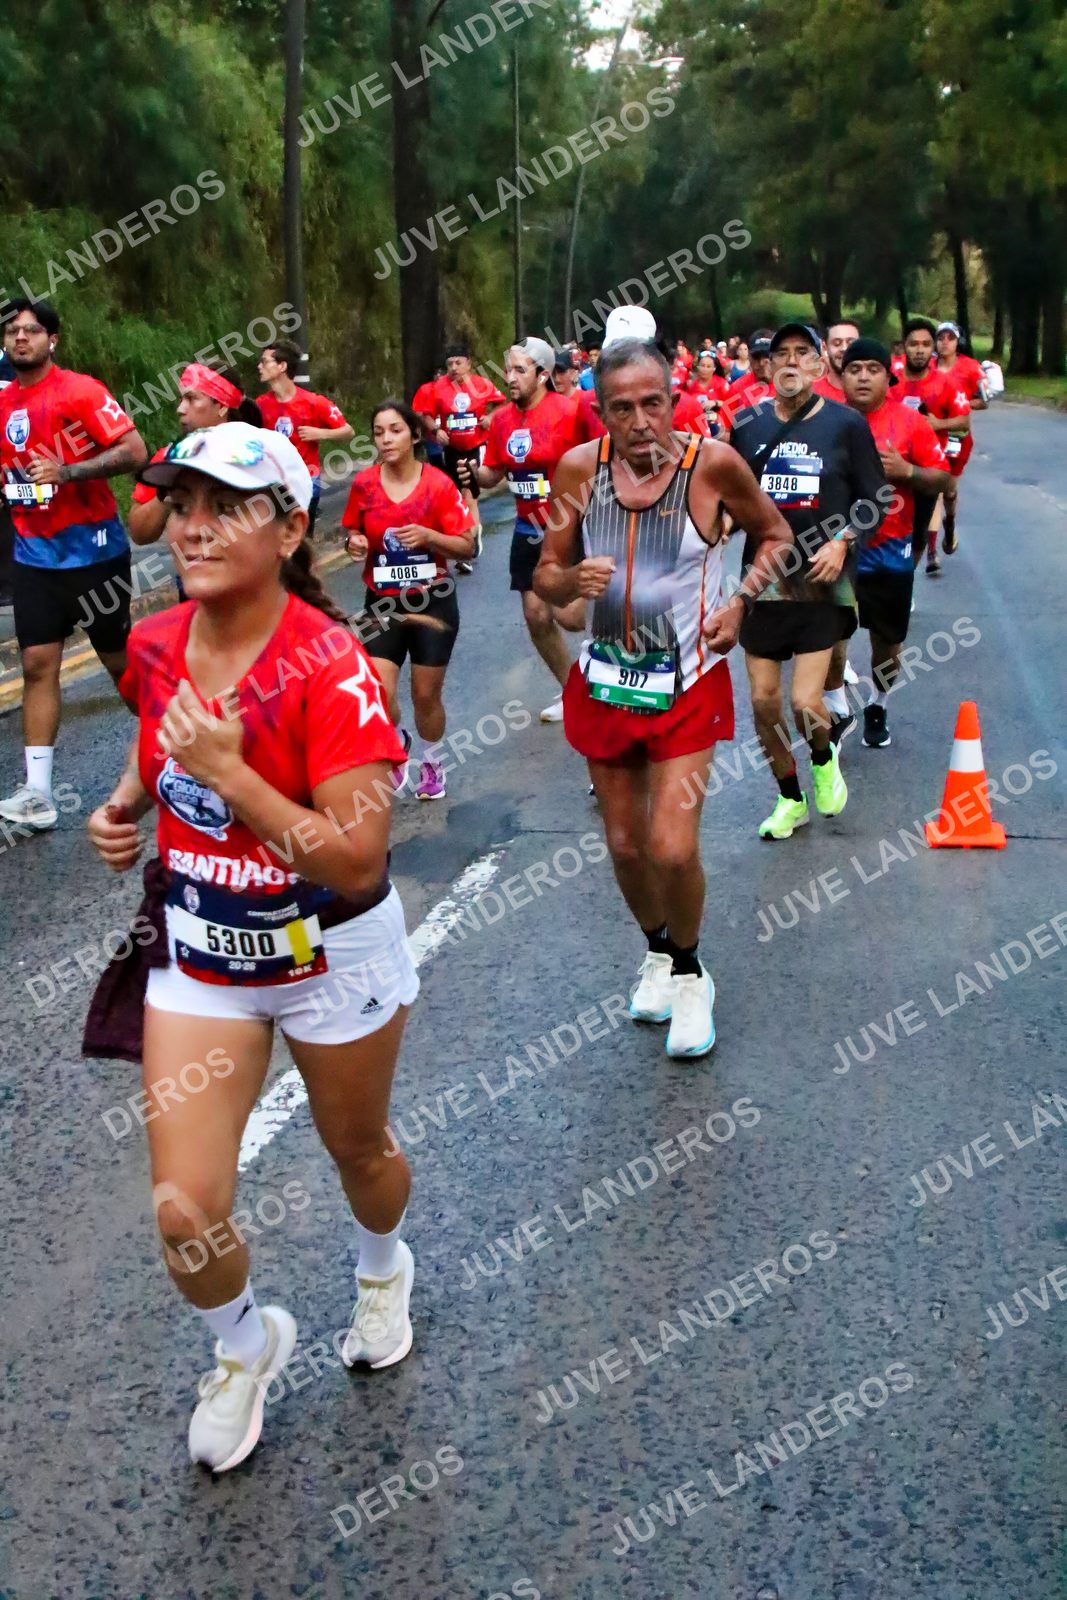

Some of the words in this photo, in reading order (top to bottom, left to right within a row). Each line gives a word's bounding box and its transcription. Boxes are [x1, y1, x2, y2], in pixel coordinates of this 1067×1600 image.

[778, 442, 809, 455] MEDIO
[517, 483, 535, 494] 5719
[768, 476, 798, 491] 3848
[16, 485, 34, 498] 5113
[390, 566, 419, 580] 4086
[618, 668, 649, 689] 907
[173, 779, 211, 800] Global
[206, 924, 277, 958] 5300
[288, 965, 313, 978] 10K
